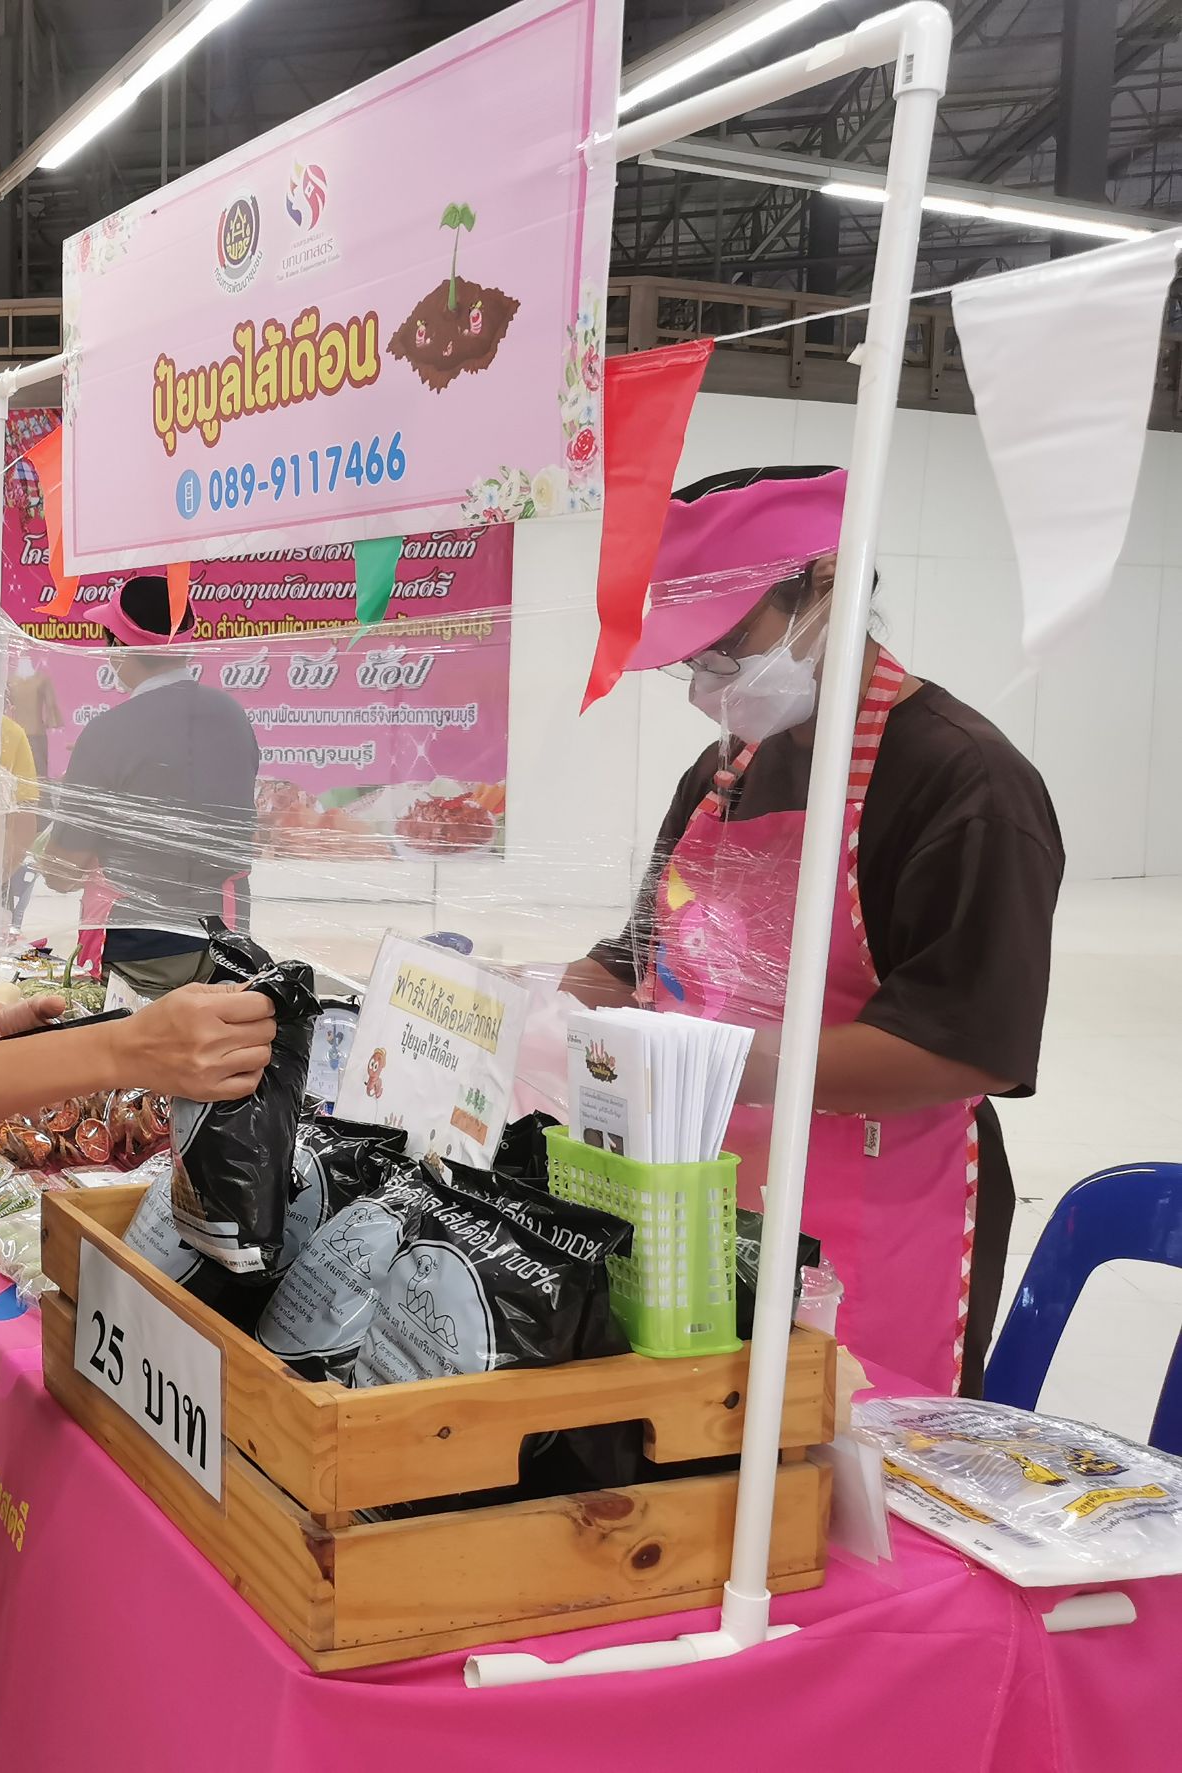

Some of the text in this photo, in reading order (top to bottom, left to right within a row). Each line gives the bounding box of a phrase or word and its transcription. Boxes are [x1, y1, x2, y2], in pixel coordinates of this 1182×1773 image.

[154, 310, 379, 453] ปุ๋ยมูลไส้เดือน
[208, 431, 406, 512] 089-9117466
[259, 744, 374, 766] ขากาญจนบุรี
[401, 1022, 459, 1072] ปุ๋ยมูลไส้เดือน
[501, 1246, 561, 1294] 100%
[89, 1309, 207, 1470] 25 บาท
